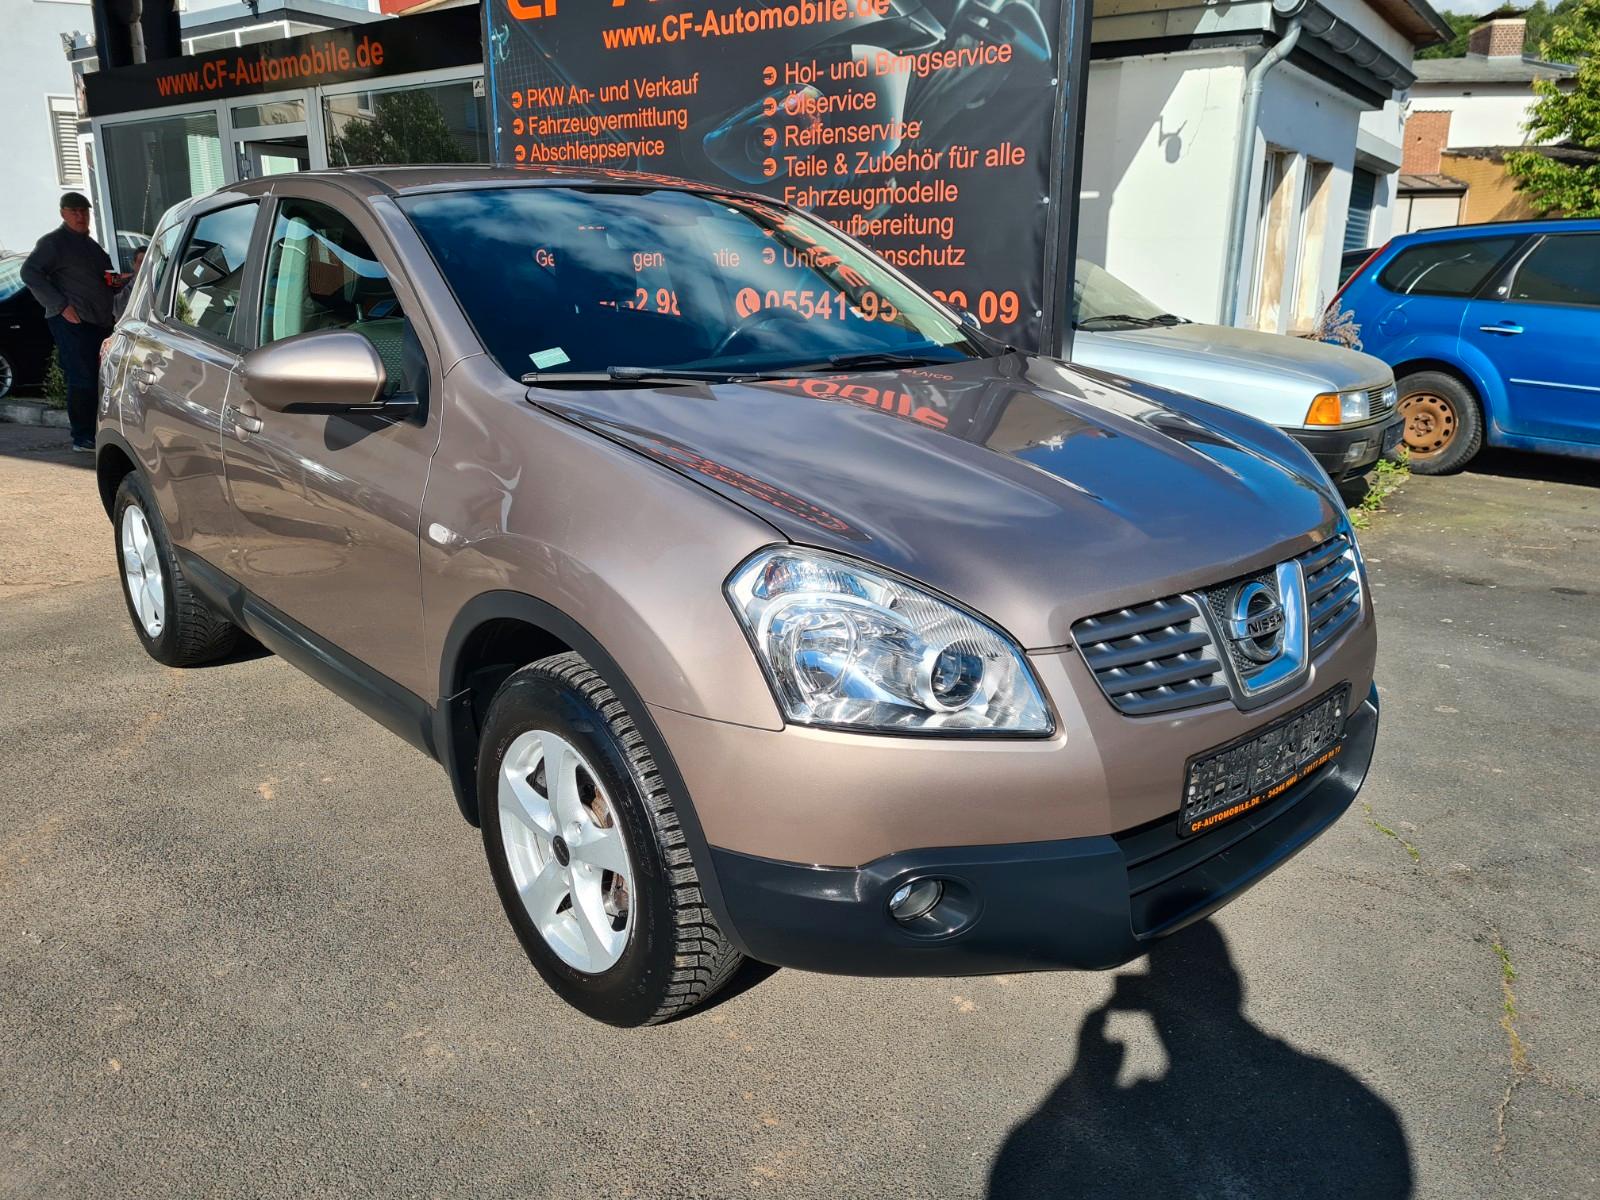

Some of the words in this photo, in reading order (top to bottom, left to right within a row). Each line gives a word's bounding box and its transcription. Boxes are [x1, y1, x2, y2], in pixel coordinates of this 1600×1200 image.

[602, 0, 891, 49] www.CF-Automobile.de
[156, 36, 385, 97] www.CF-Automobile.de
[785, 59, 824, 84] Hol-
[830, 54, 868, 80] und
[874, 42, 1013, 78] Bringservice
[527, 86, 564, 108] PKW
[568, 84, 596, 106] An-
[600, 80, 629, 102] und
[634, 72, 700, 99] Verkauf
[784, 89, 877, 117] Ölservice
[528, 107, 689, 136] Fahrzeugvermittlung
[784, 119, 921, 147] Reifenservice
[530, 137, 665, 164] Abschleppservice
[783, 154, 828, 177] Teile
[833, 153, 848, 175] &
[854, 147, 943, 175] Zubehör
[948, 145, 979, 169] für
[984, 142, 1026, 167] alle
[783, 180, 959, 211] Fahrzeugmodelle
[978, 290, 1020, 324] 09
[1191, 797, 1260, 832] CF-AUTOMOBILE.DE
